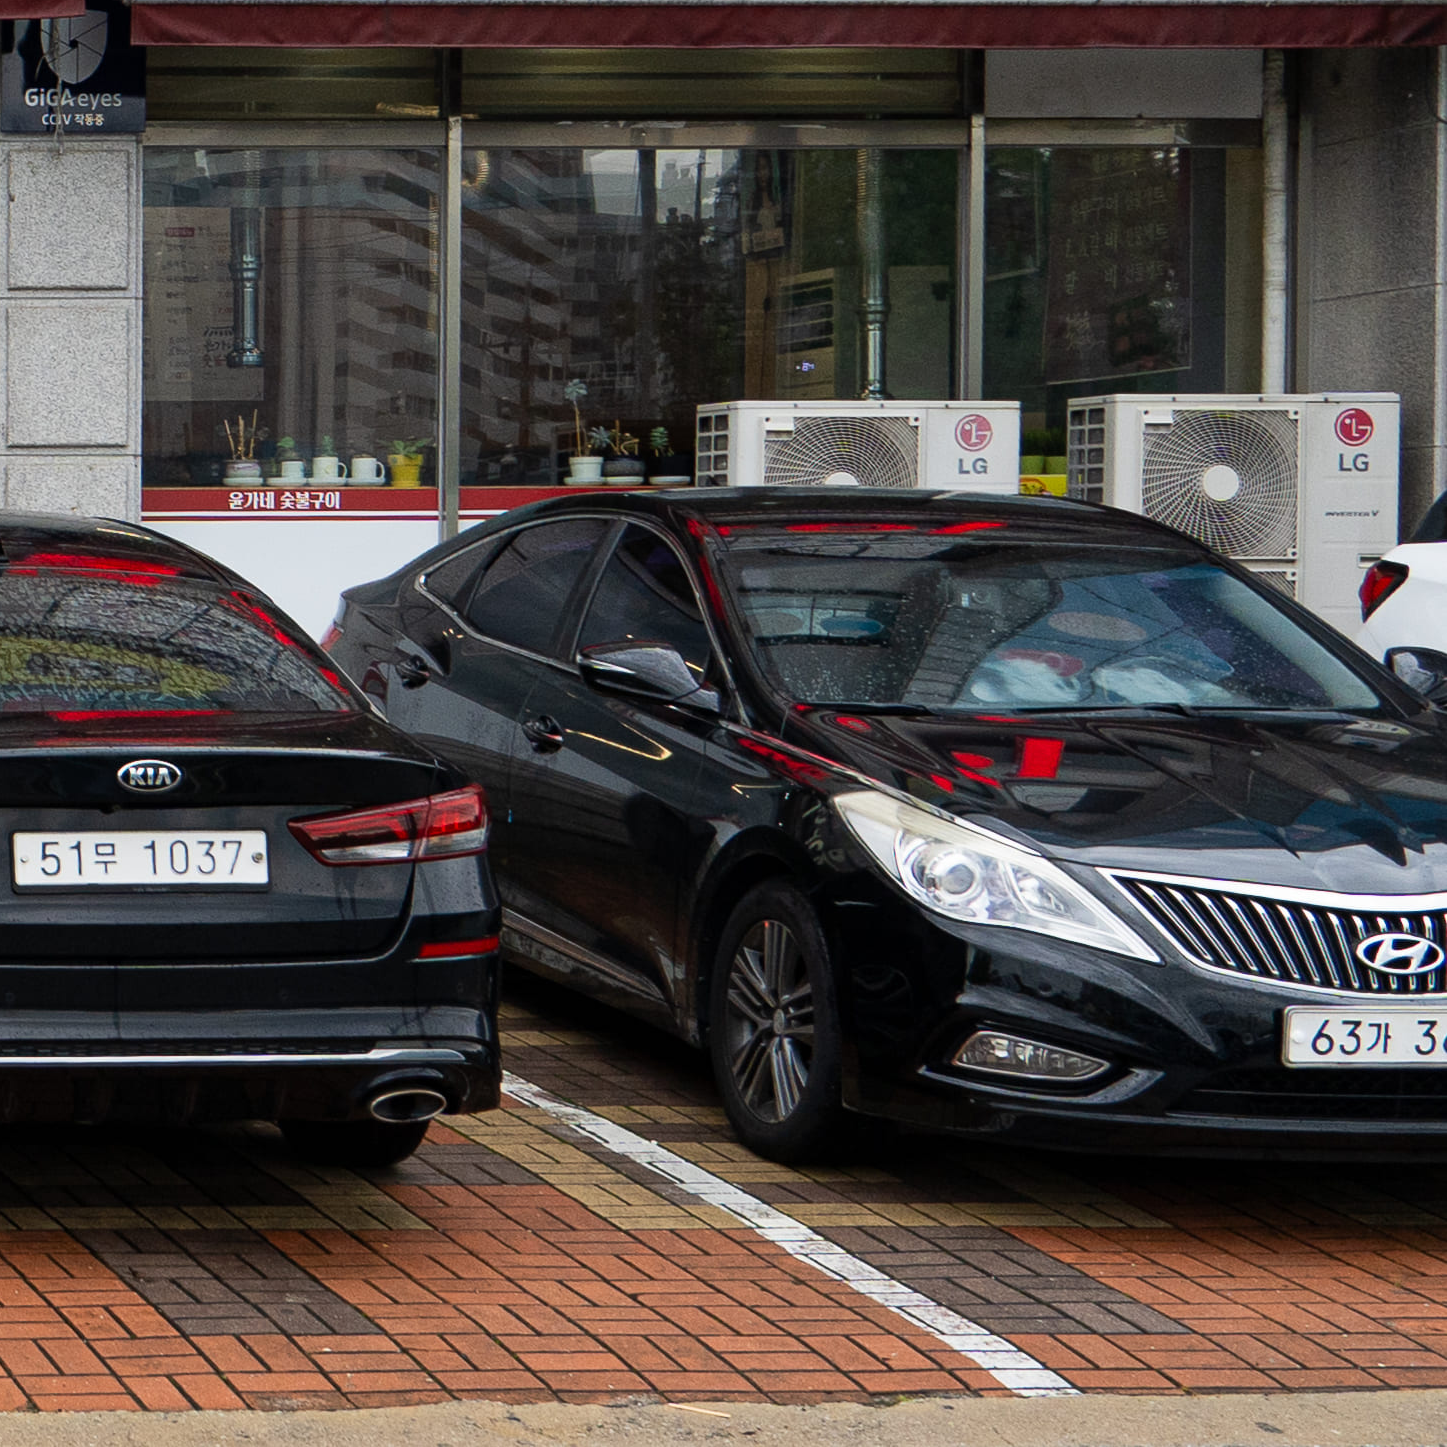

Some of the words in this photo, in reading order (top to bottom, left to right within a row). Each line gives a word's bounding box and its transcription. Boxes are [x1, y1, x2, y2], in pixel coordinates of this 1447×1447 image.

[957, 457, 988, 474] LG
[1338, 453, 1369, 472] LG
[228, 491, 275, 509] 윤가네
[279, 491, 341, 509] 숯불구이
[129, 767, 172, 786] KIA
[40, 840, 118, 877] 51무
[143, 839, 243, 876] 1037
[1311, 1019, 1392, 1055] 63가
[1414, 1019, 1447, 1055] 3
